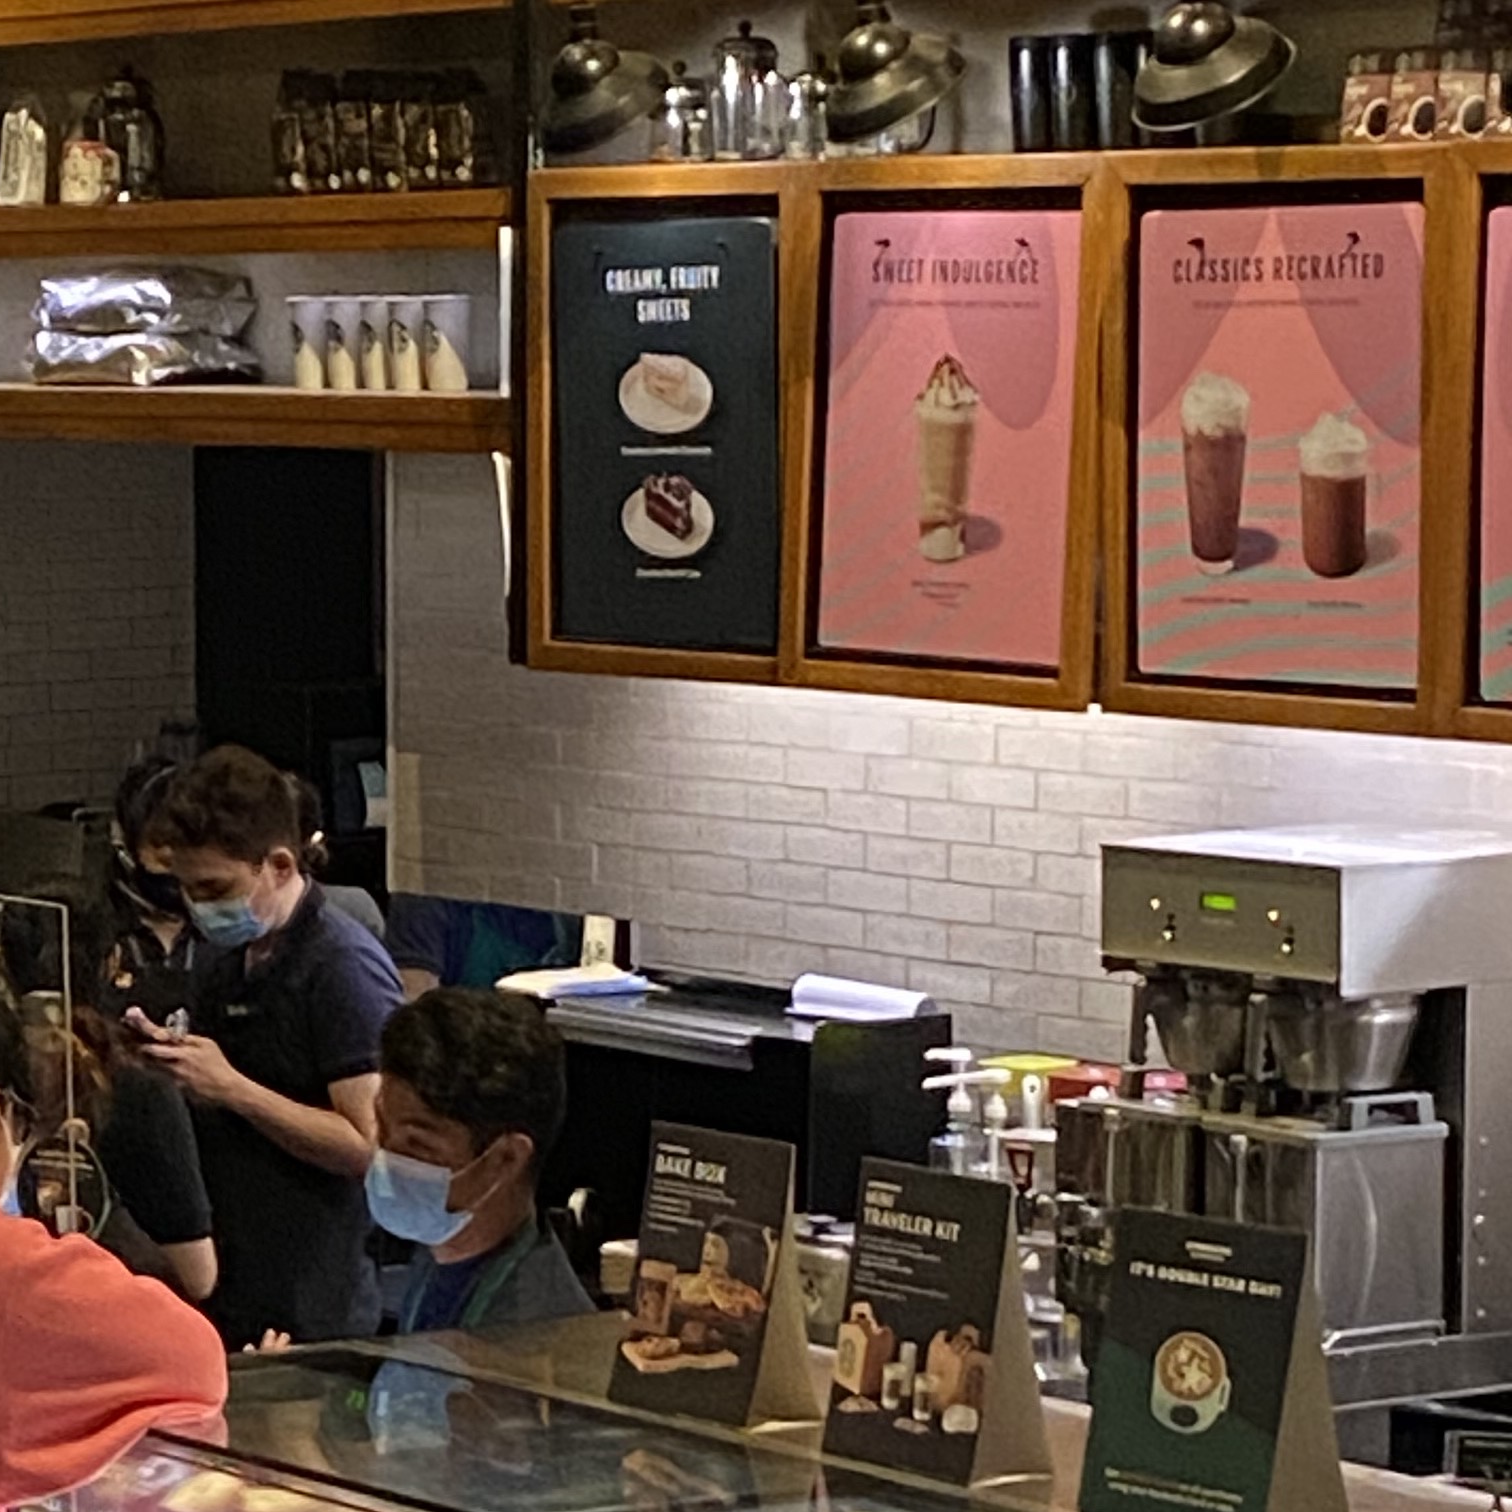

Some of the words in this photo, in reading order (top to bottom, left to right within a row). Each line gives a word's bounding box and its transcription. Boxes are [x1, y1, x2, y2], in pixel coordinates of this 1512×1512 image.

[872, 257, 924, 284] SWEET
[931, 258, 1039, 285] INDULGENCE
[1172, 256, 1264, 284] CLASSICS
[1272, 251, 1384, 282] RECRAFTED
[636, 298, 691, 324] SWEETS
[864, 1207, 933, 1237] TRAVELER
[935, 1220, 961, 1243] KIT
